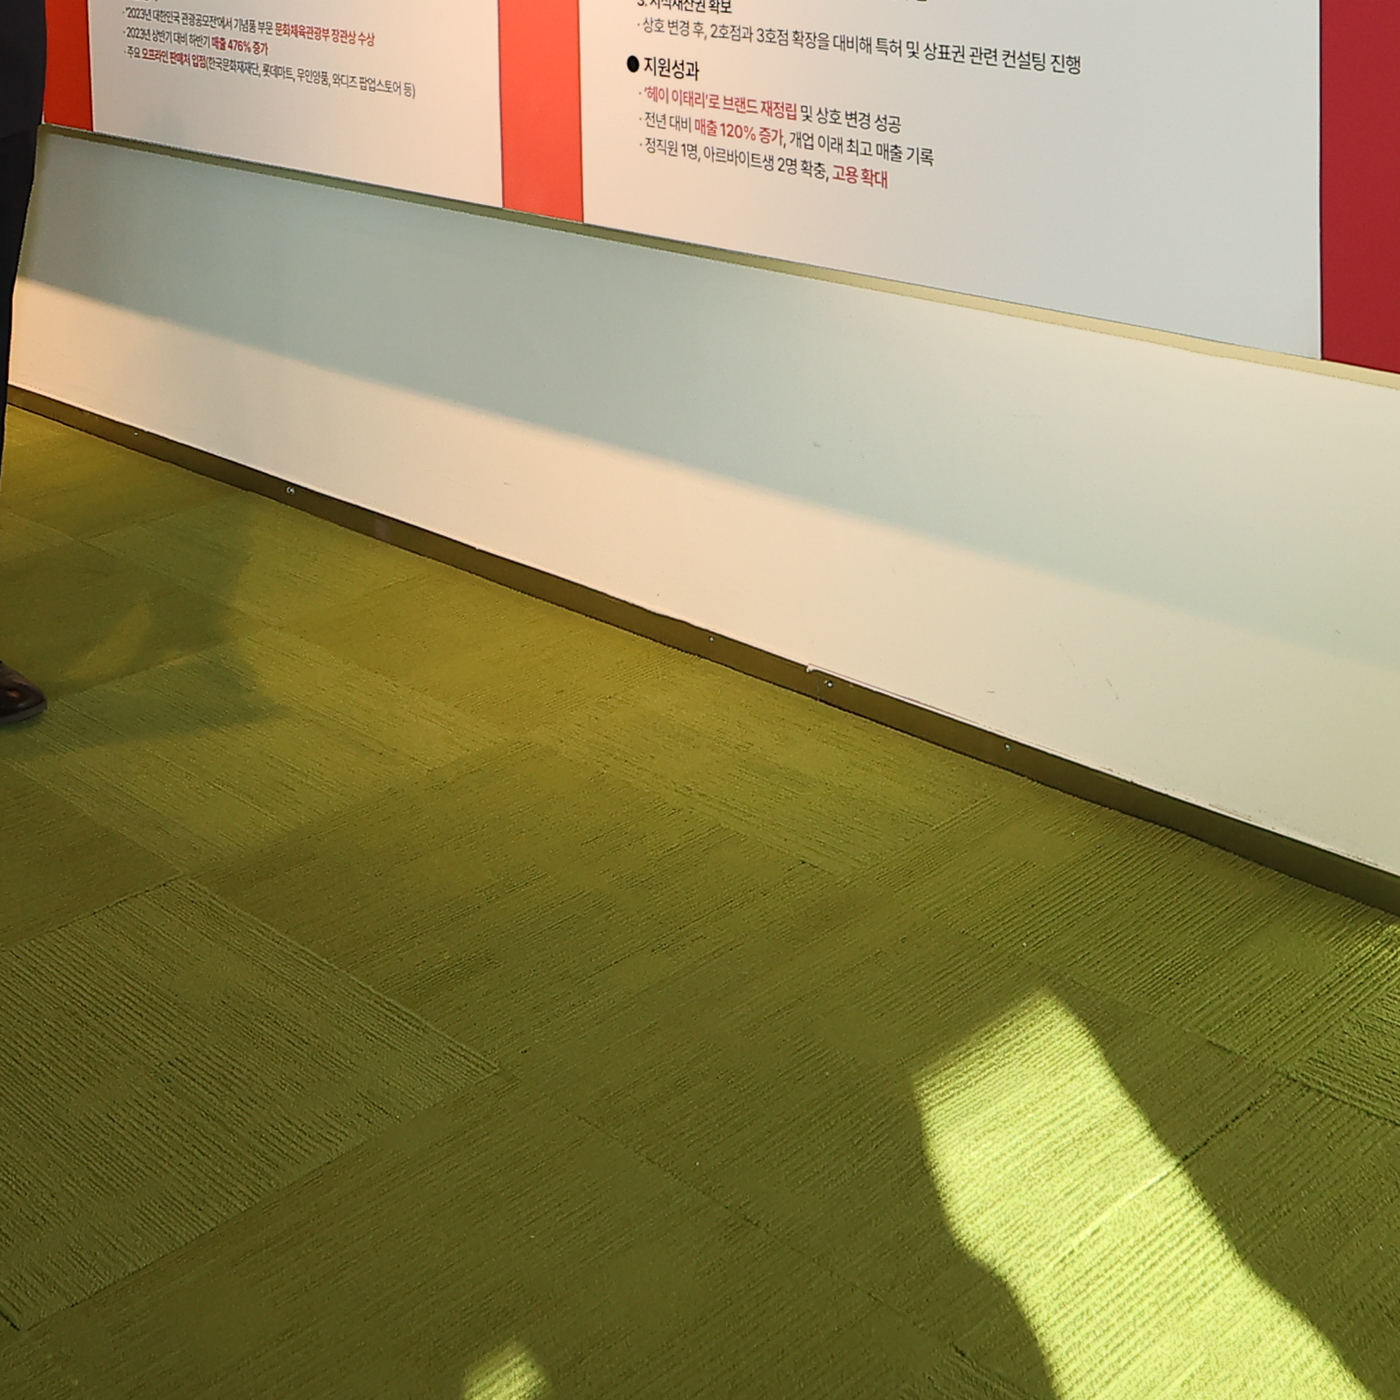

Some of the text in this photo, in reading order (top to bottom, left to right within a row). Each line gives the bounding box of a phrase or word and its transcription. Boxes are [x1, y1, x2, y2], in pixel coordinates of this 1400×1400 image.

[127, 27, 268, 56] 2023년 상반기 대비 하반기 매출 476% 증가
[644, 57, 699, 81] 지원성과
[645, 112, 934, 167] 전년 대비 매출 120% 증가, 개업 이래 최고 매출 기록
